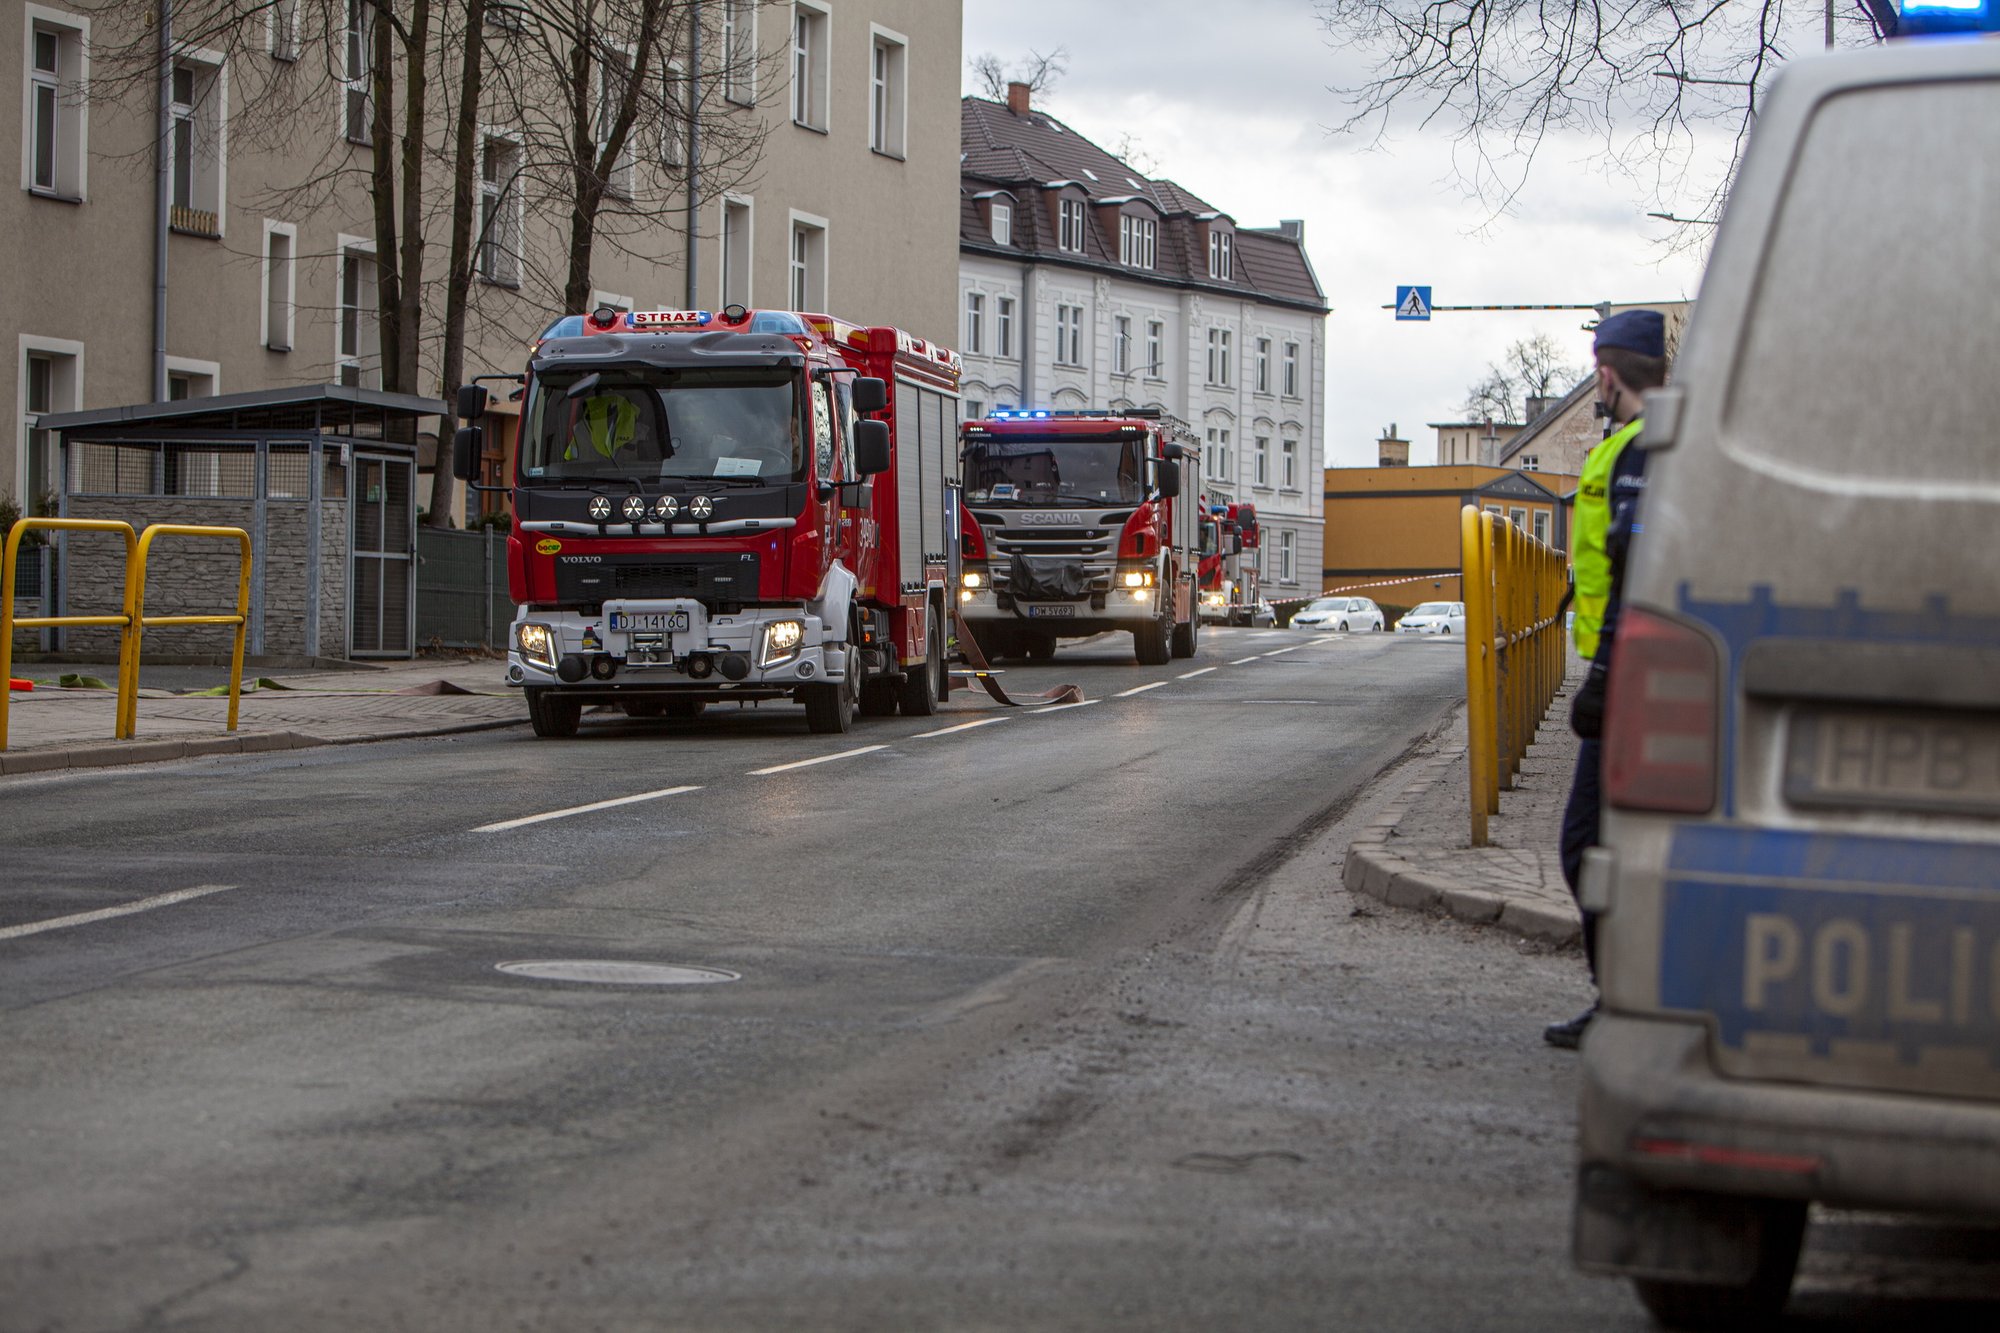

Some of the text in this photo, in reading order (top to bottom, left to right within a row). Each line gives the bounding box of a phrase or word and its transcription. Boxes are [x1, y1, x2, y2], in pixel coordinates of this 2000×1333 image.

[1020, 513, 1082, 524] SCANIA
[620, 615, 684, 629] DJ 1416C
[1743, 912, 2000, 1024] POLI
